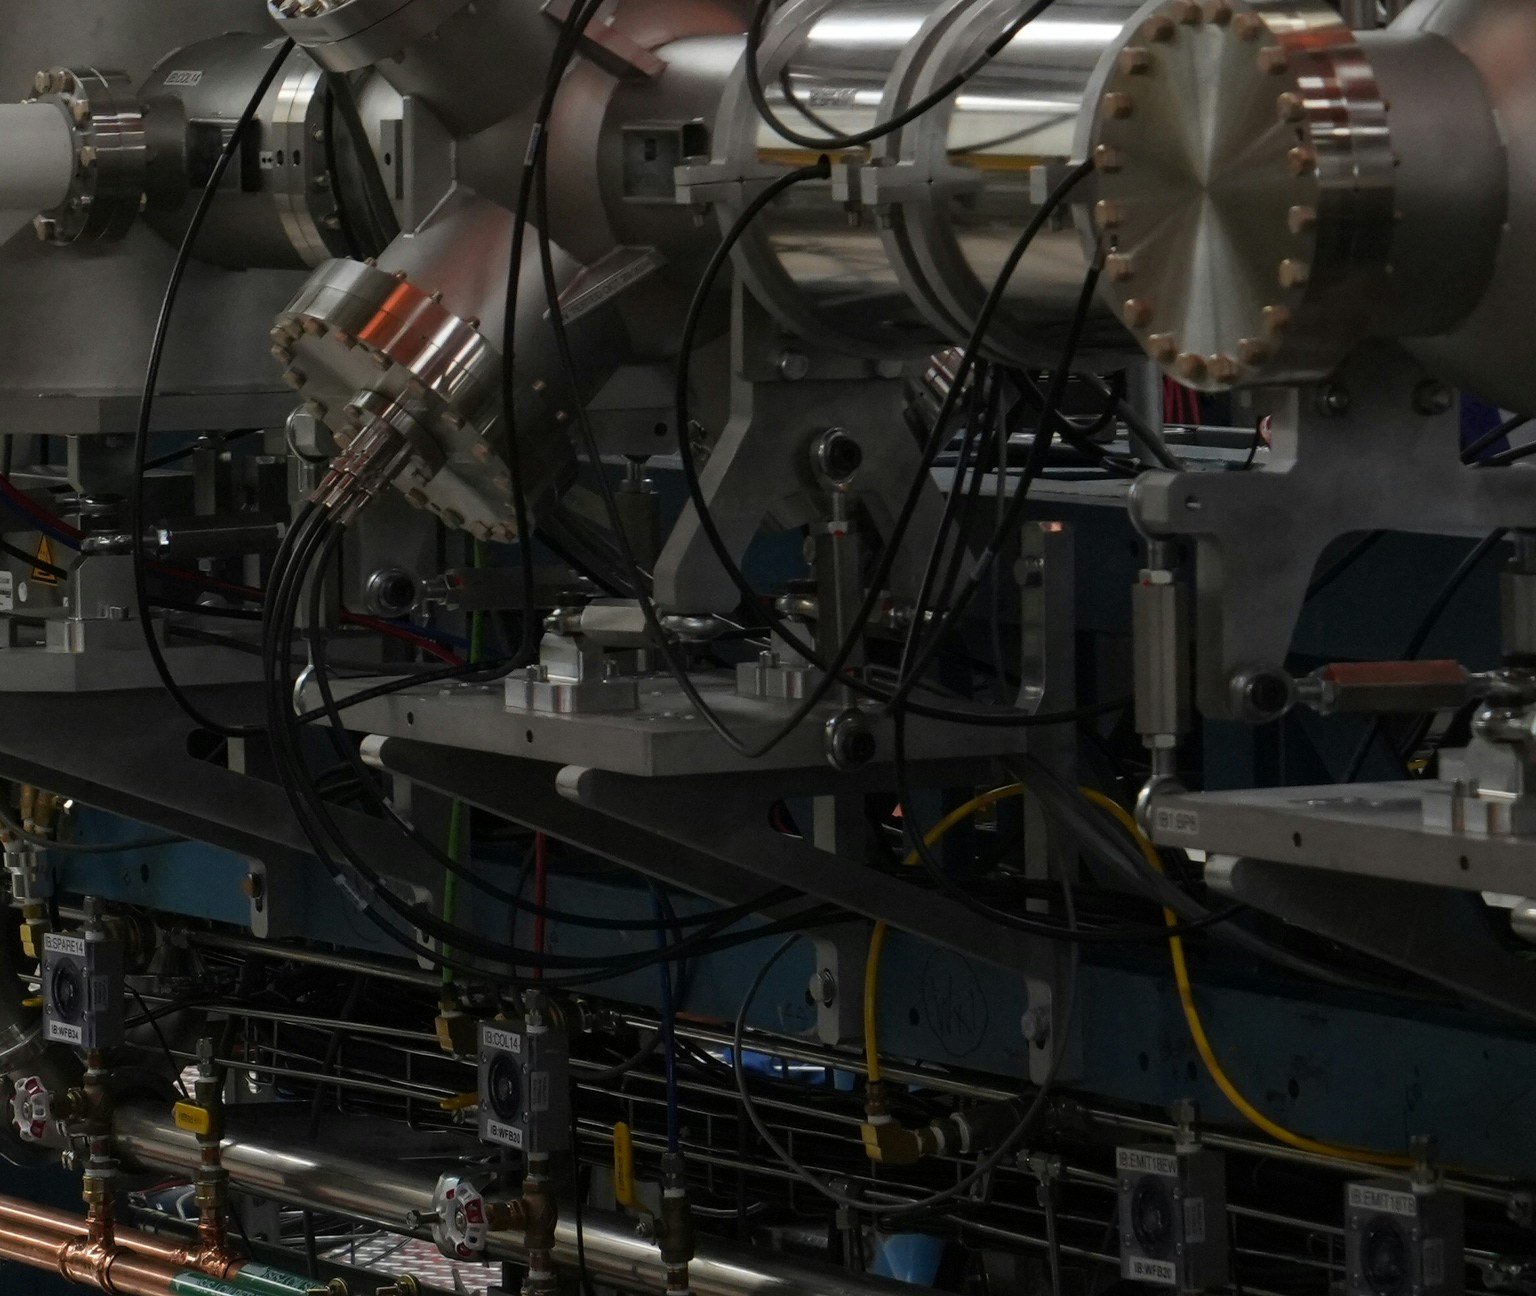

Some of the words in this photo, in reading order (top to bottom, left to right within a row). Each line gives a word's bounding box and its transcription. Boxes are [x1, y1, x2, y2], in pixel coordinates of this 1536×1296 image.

[45, 935, 84, 954] IB:SPARE14
[51, 1024, 79, 1040] IB:WFB34
[485, 1031, 519, 1050] IB:COL14
[490, 1124, 521, 1144] IB:WFB20
